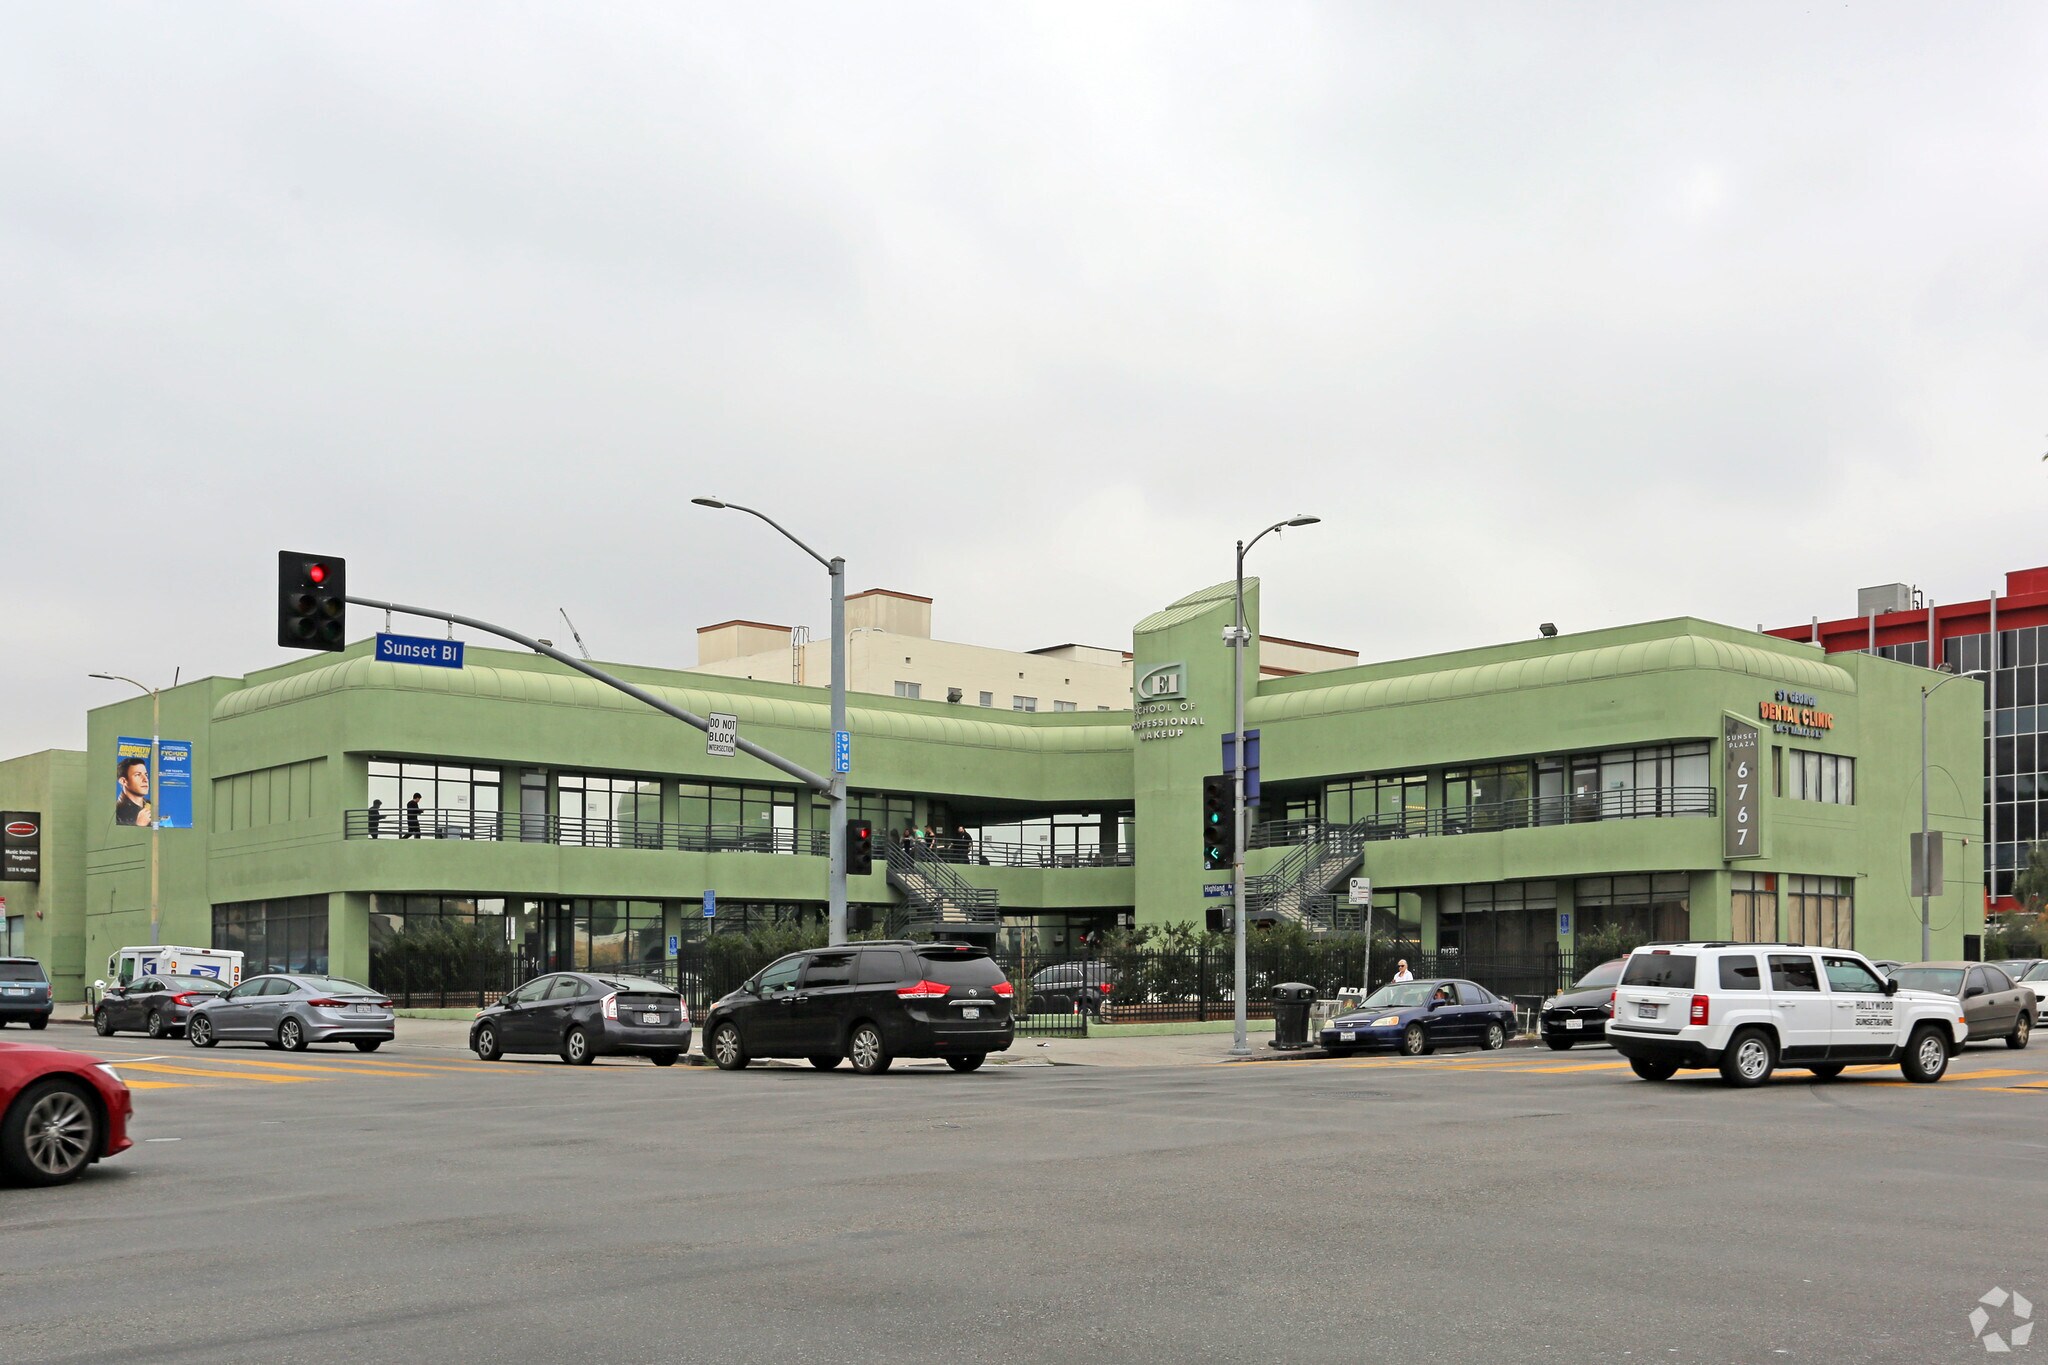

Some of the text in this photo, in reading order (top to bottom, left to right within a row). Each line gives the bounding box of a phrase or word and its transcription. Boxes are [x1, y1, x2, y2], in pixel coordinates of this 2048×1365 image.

[384, 640, 457, 661] Sunset Bl
[1180, 702, 1196, 711] OF
[1760, 701, 1834, 730] DENTAL CLINIC
[710, 717, 736, 730] DO NOT
[1132, 716, 1205, 732] OFESSIONAL
[709, 731, 735, 743] BLOCK
[1139, 728, 1184, 741] MAKEUP
[1726, 732, 1758, 741] SUNSET
[119, 744, 151, 754] BROOKLYN
[708, 743, 734, 753] INTERSECTION
[841, 734, 849, 770] SYNC
[1737, 761, 1748, 845] 6767
[1204, 885, 1225, 894] Highland
[1856, 1001, 1894, 1010] HOLLYWOOD
[1855, 1018, 1893, 1027] SUNSET&VINE
